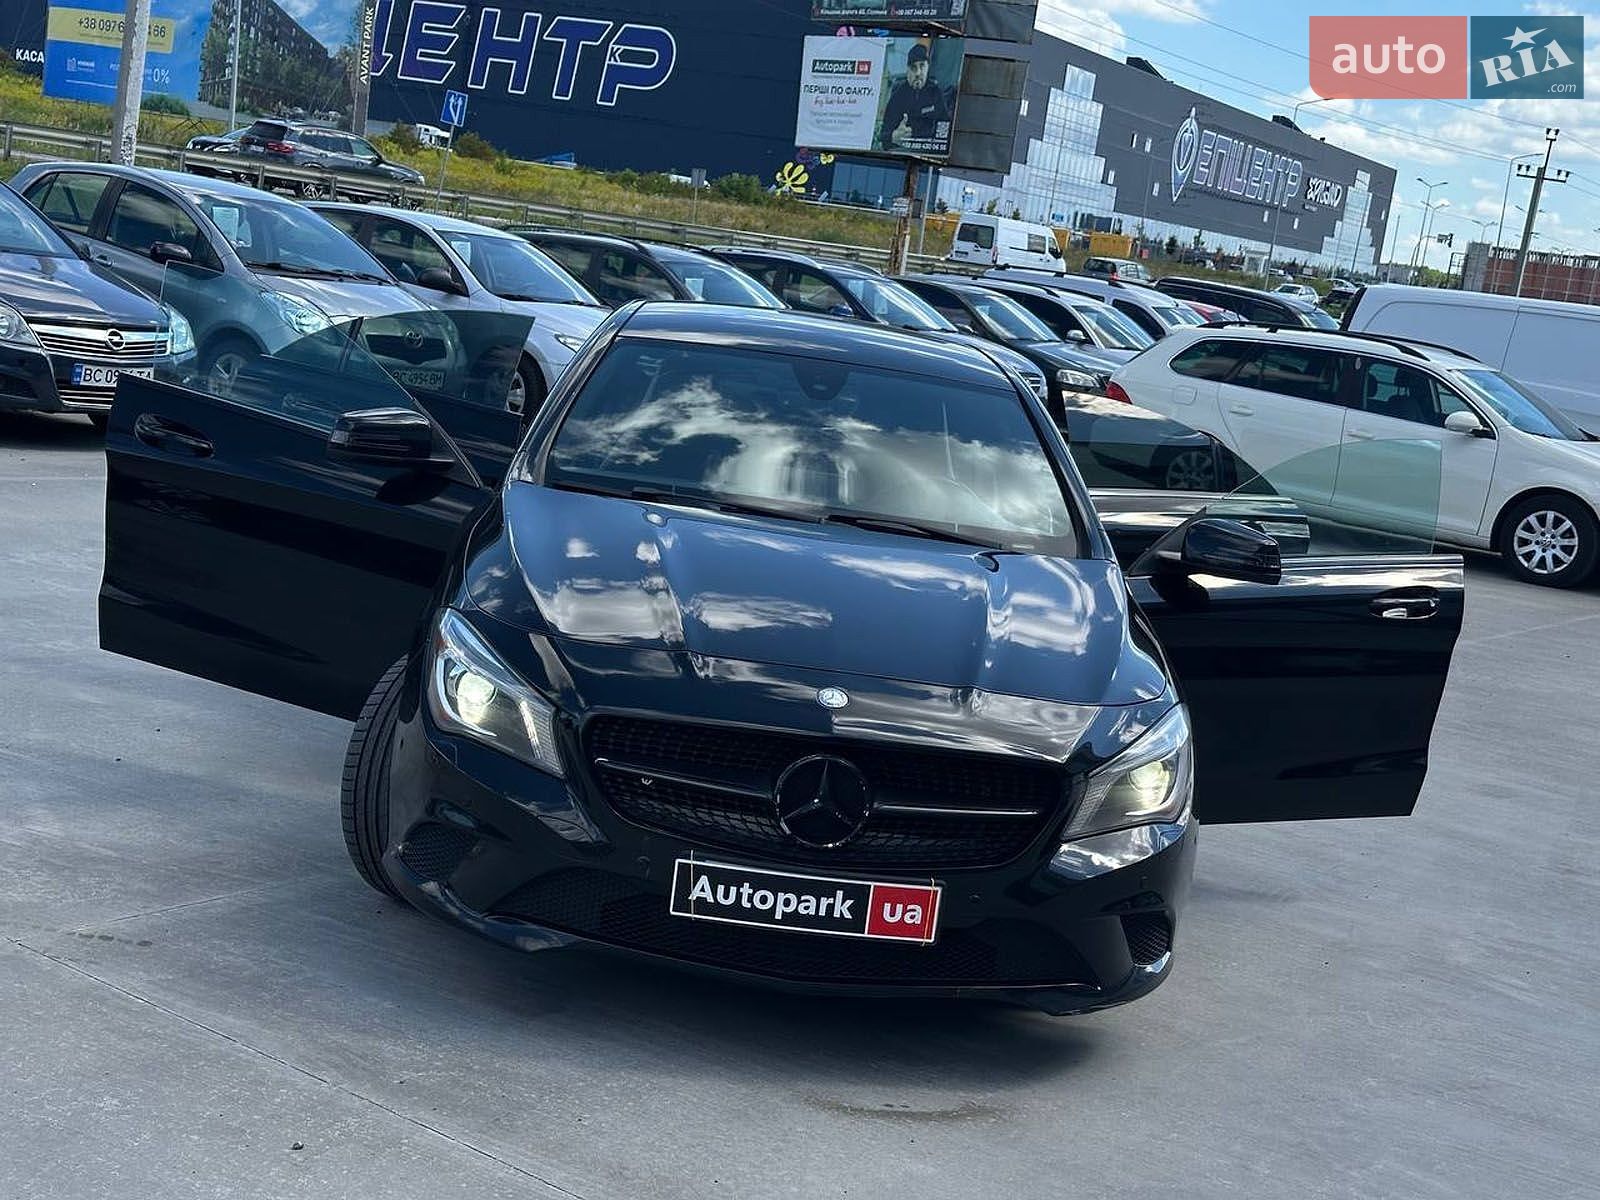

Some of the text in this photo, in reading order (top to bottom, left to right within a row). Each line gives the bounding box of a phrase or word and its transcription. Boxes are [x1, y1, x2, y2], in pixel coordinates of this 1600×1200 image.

[78, 17, 96, 30] +38
[360, 7, 374, 85] AVANT PARK
[814, 61, 854, 73] Autopark
[831, 85, 844, 95] ПО
[1192, 129, 1304, 208] ЕПІЦЕНТР
[83, 368, 103, 383] BC
[688, 875, 923, 925] Autopark ua
